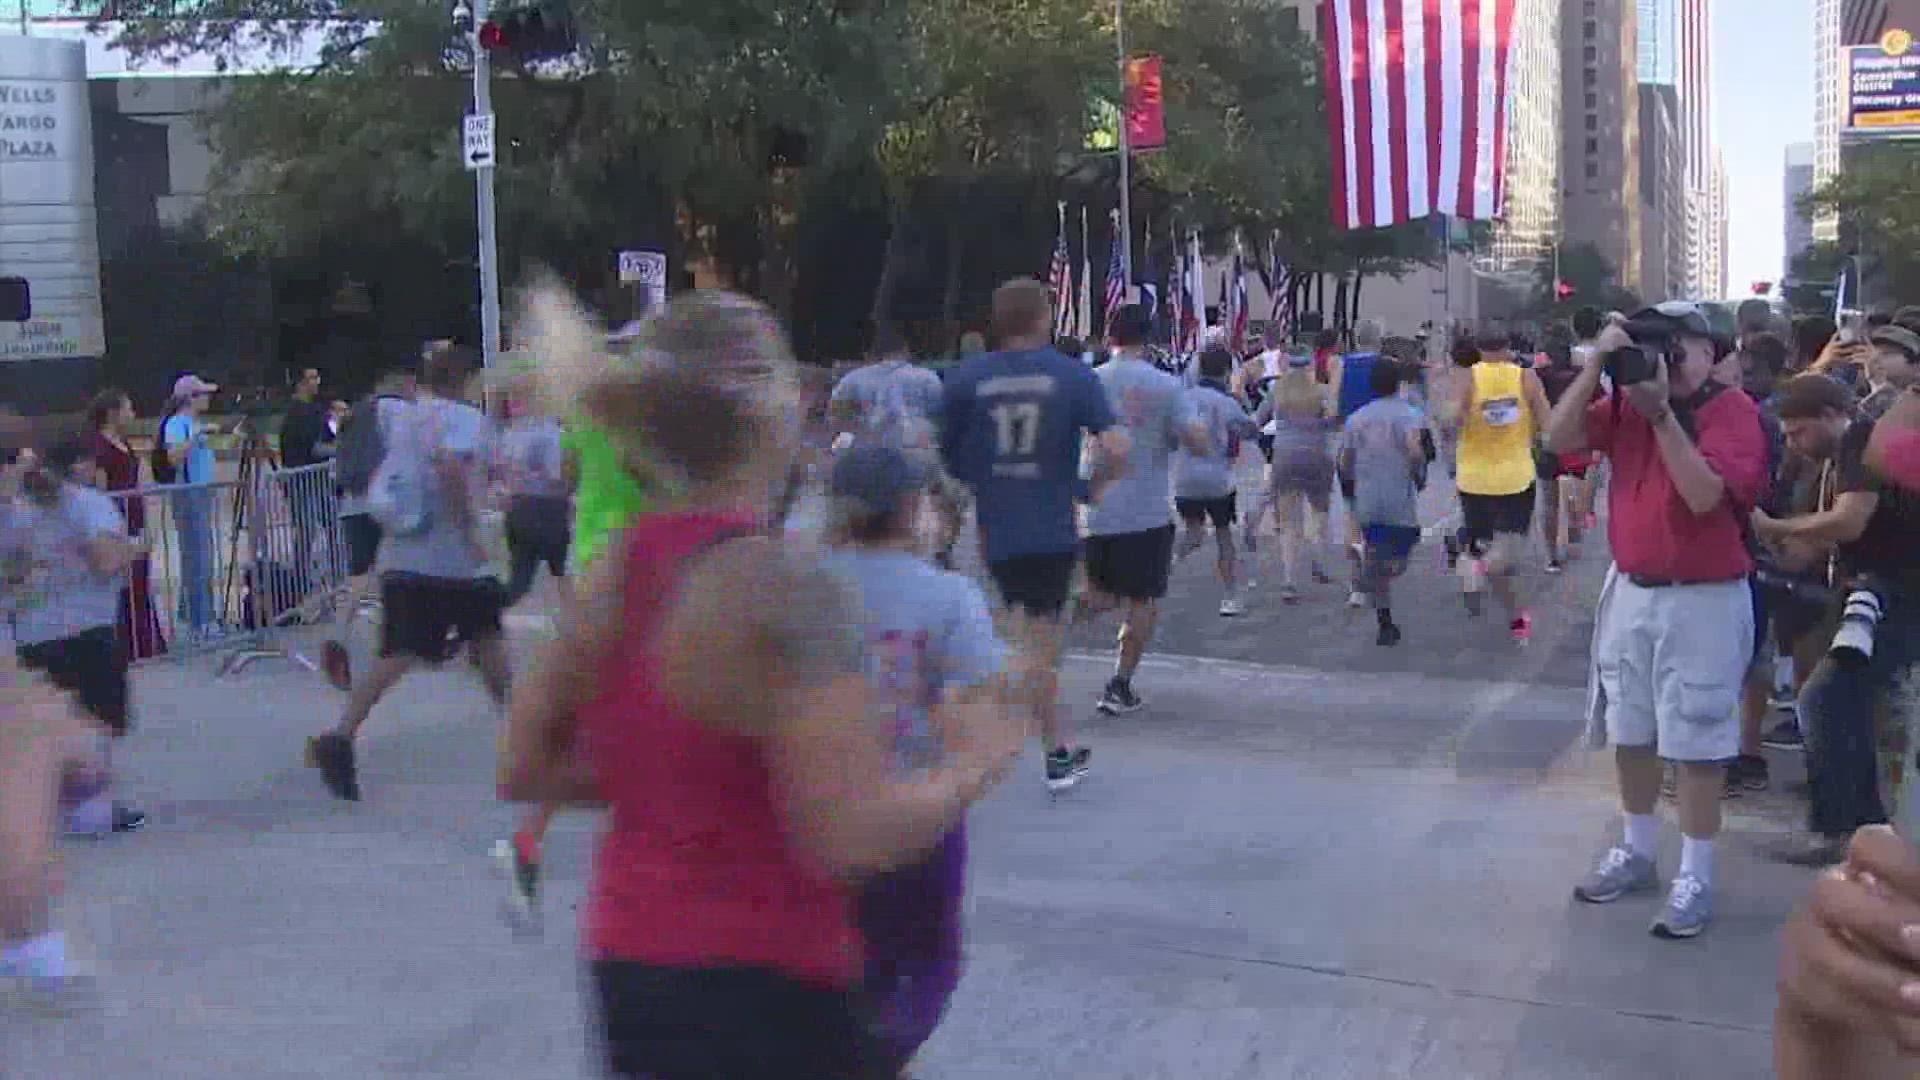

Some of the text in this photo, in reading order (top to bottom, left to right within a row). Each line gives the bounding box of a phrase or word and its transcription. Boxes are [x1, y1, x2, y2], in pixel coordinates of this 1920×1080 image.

[0, 115, 56, 131] ARGO
[469, 118, 489, 130] ONE
[469, 134, 489, 147] WAY
[987, 403, 1040, 455] 17
